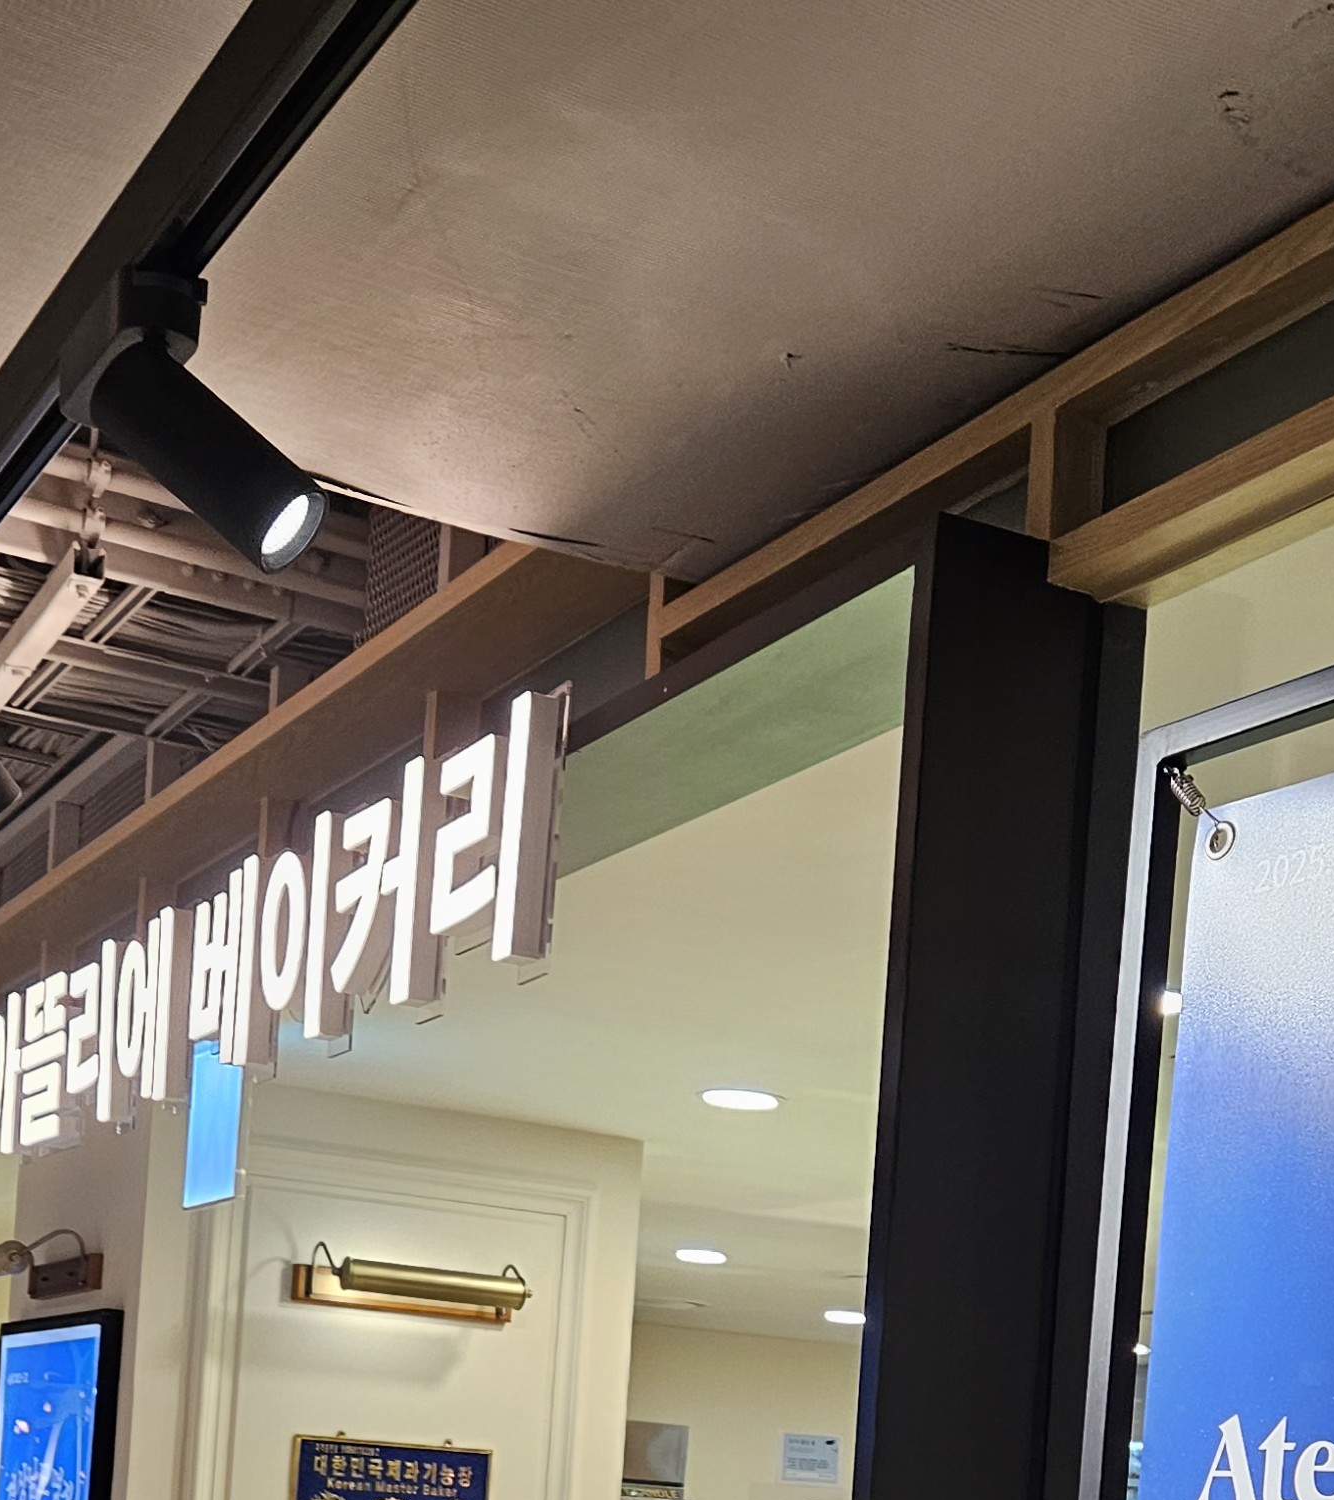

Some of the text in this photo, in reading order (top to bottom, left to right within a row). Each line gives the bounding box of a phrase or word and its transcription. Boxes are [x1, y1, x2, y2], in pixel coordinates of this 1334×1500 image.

[189, 690, 532, 1066] 베이커리
[326, 1478, 458, 1498] Korean Master Baker
